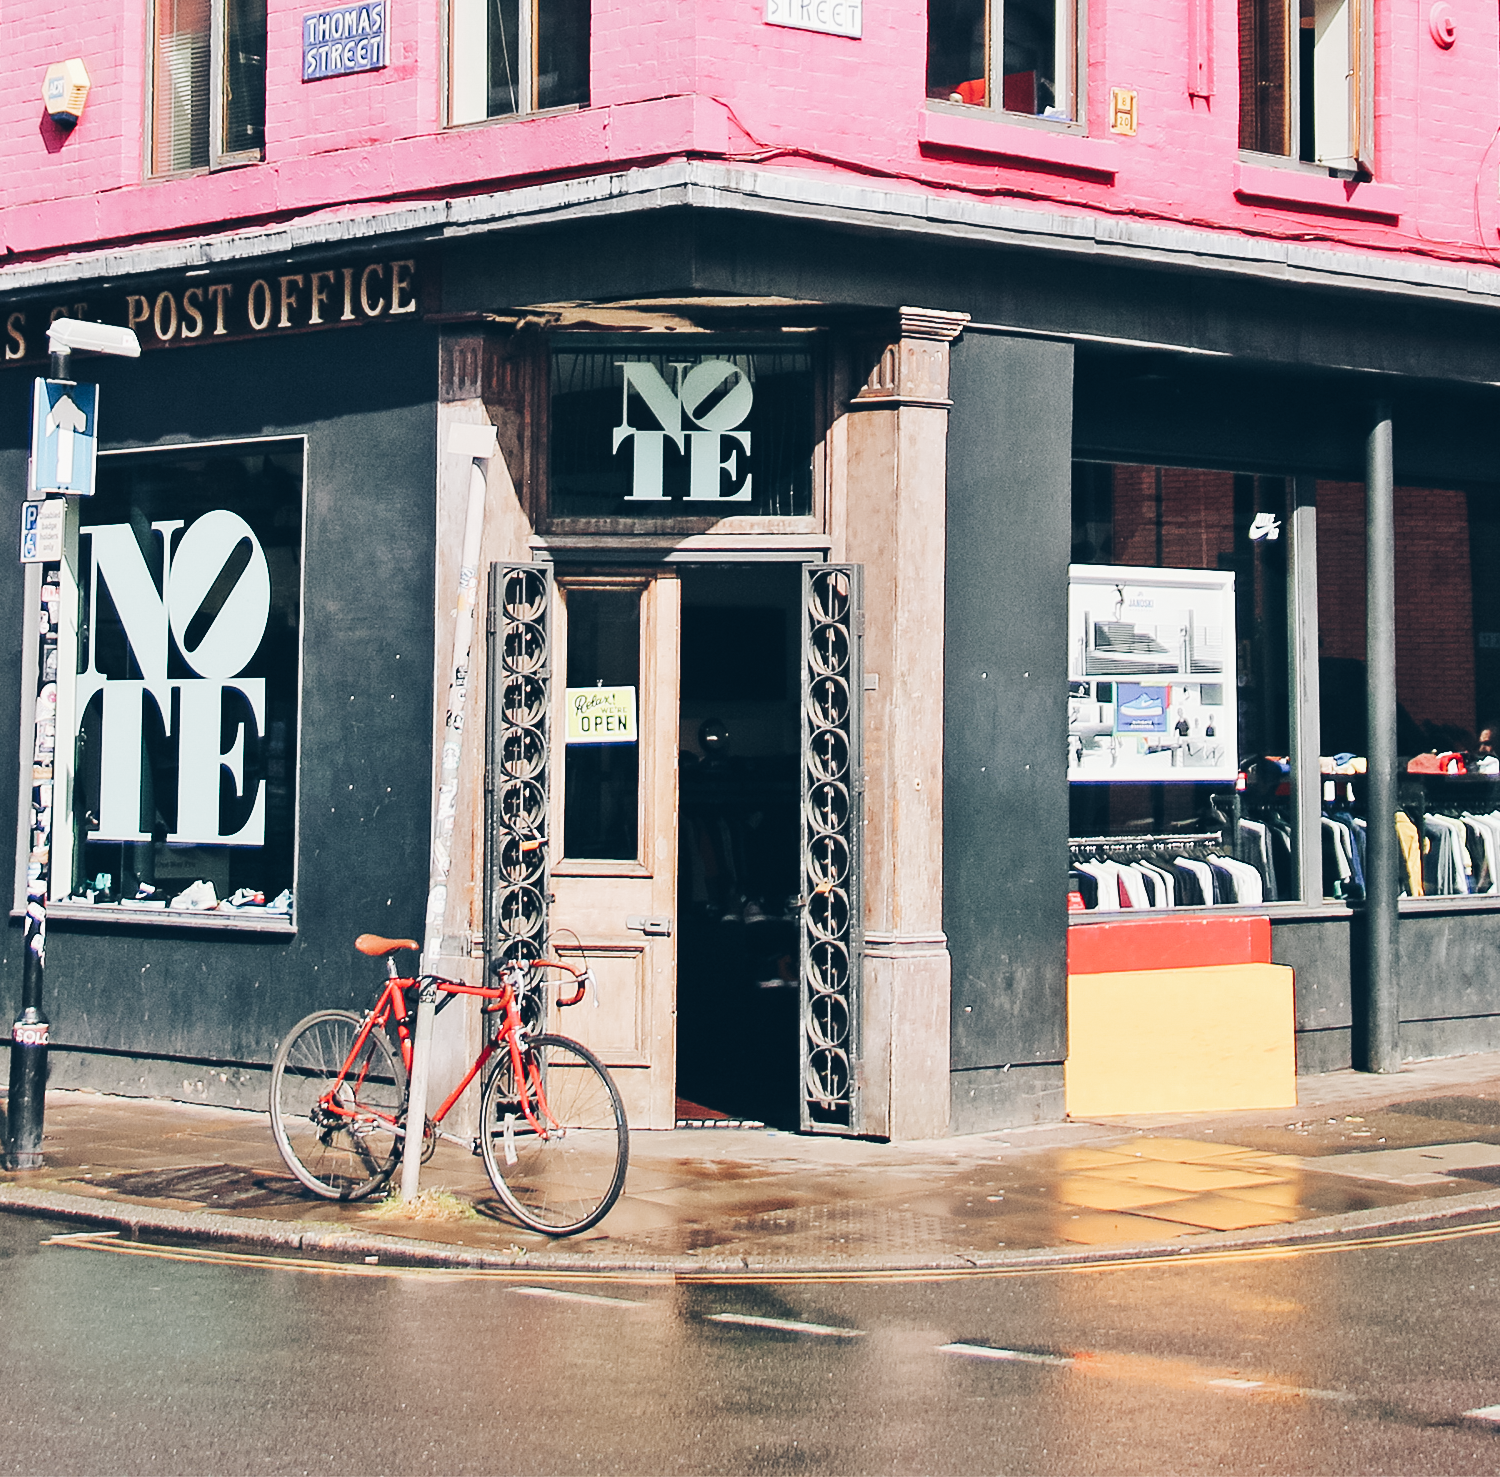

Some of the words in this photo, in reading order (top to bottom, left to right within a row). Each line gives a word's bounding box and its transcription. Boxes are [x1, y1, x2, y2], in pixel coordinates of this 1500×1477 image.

[306, 4, 382, 44] THOMAS
[306, 34, 382, 75] STREET
[48, 79, 65, 96] ADT
[125, 283, 233, 341] POST
[247, 259, 416, 331] OFFICE
[26, 506, 37, 530] P
[574, 693, 616, 717] Relax!
[600, 706, 628, 714] WE'RE
[581, 715, 627, 732] OPEN
